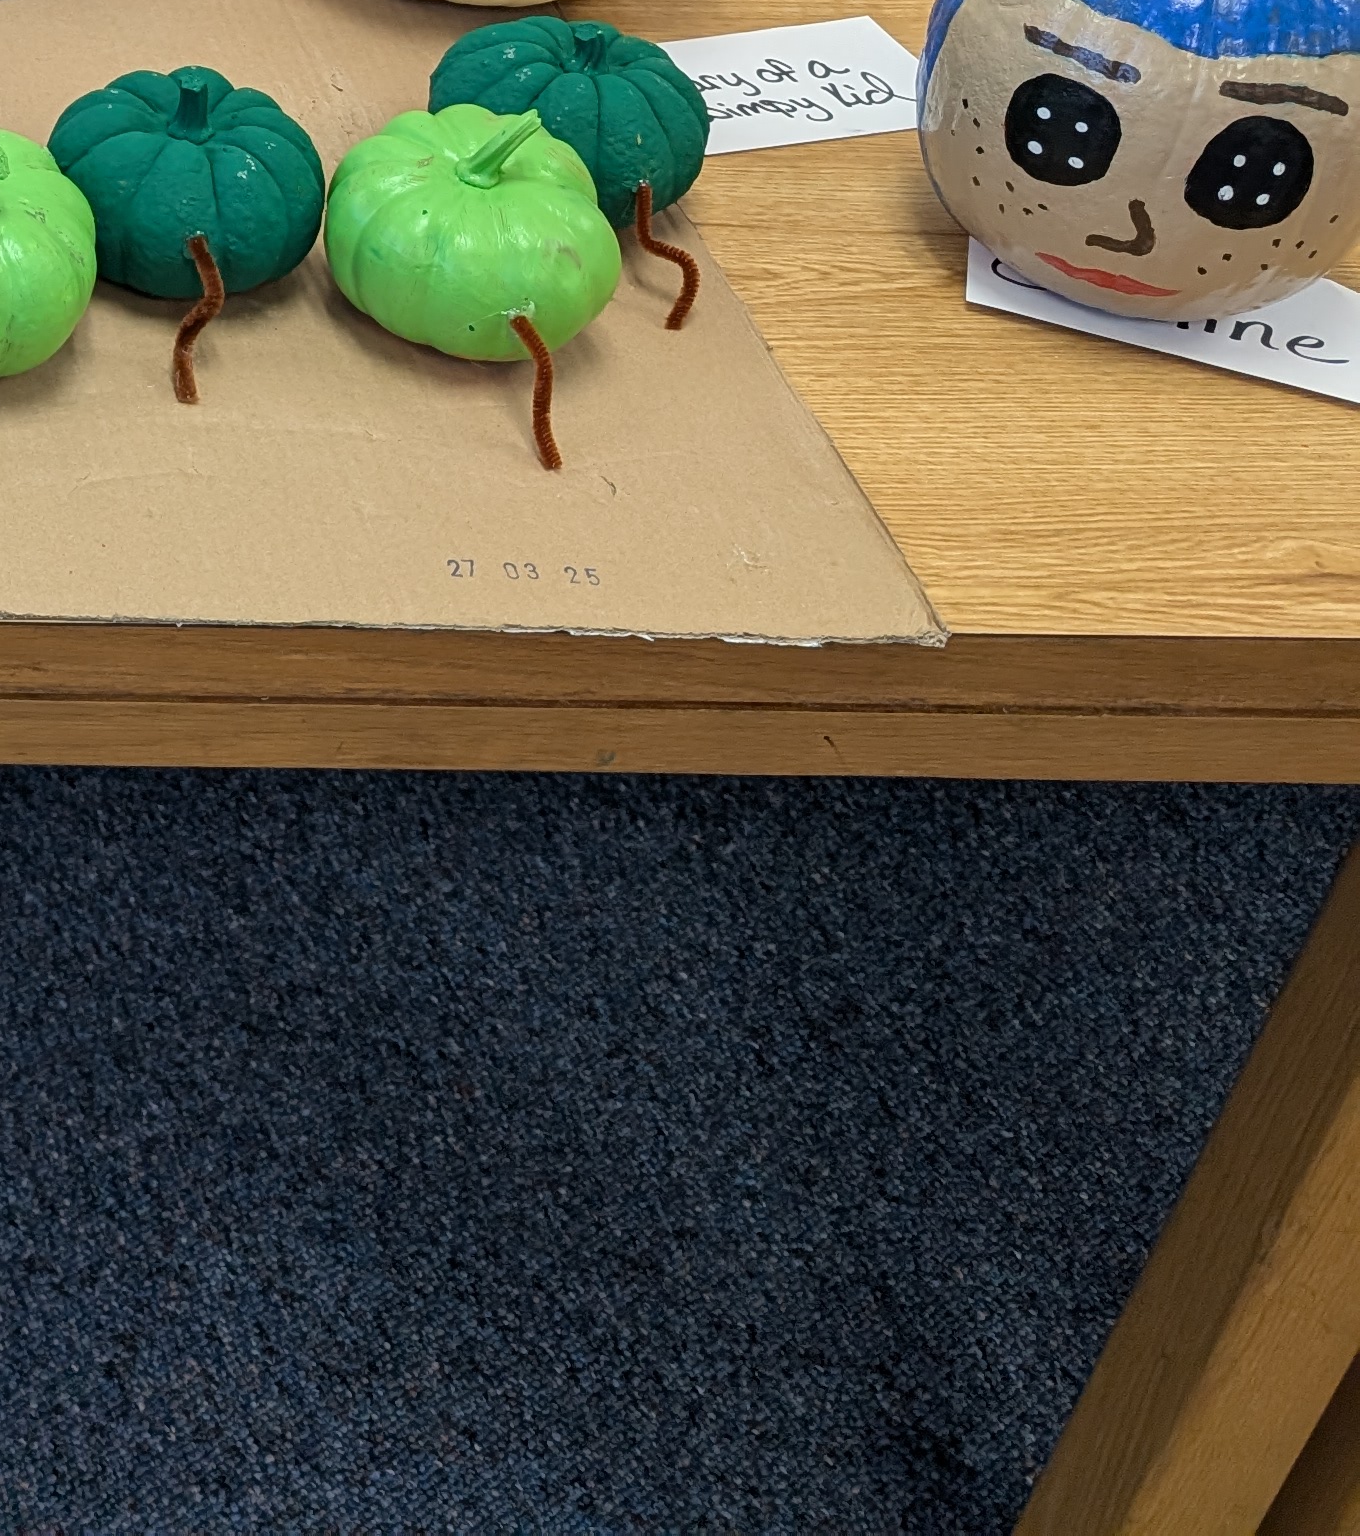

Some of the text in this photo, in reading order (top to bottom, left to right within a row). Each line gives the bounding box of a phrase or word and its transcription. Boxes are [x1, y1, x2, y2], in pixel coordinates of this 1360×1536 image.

[756, 58, 799, 83] of
[807, 59, 851, 79] a
[820, 71, 917, 108] Kid
[446, 559, 601, 586] 27 03 25
